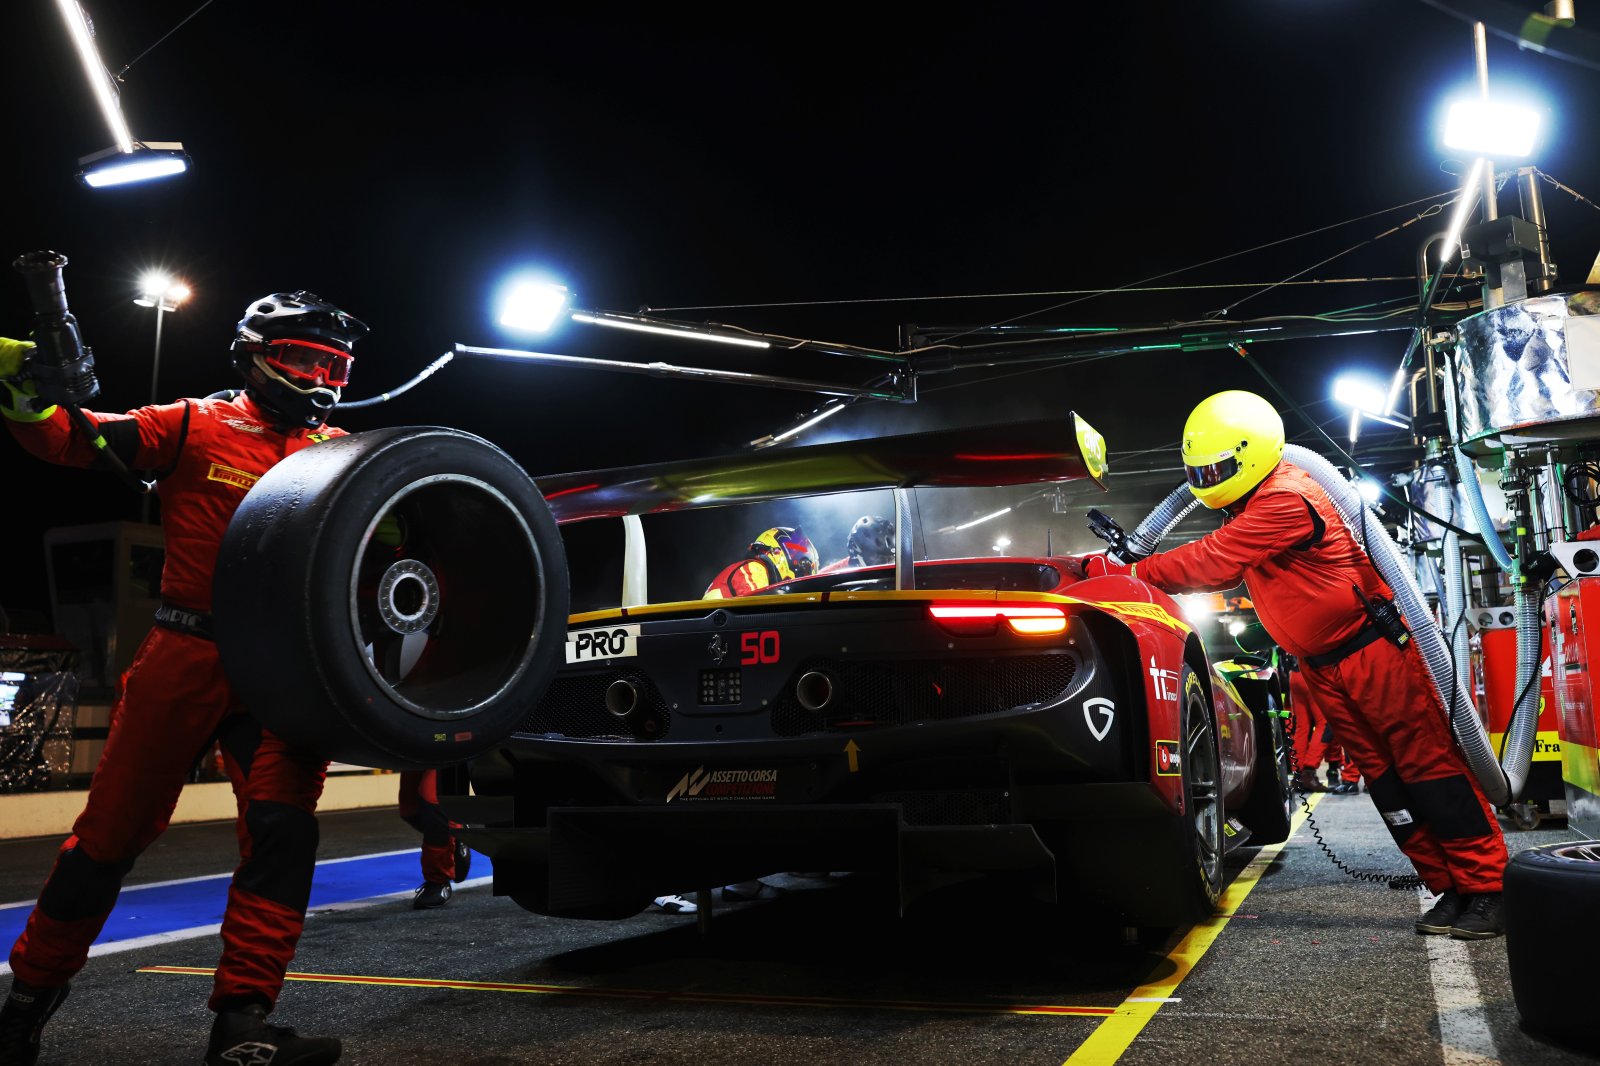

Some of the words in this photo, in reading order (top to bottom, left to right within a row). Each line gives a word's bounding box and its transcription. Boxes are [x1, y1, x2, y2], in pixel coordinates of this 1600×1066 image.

[1113, 603, 1169, 621] PIRELLI
[575, 628, 628, 659] PRO
[740, 630, 781, 665] 50
[710, 770, 748, 783] ASSETTO
[749, 769, 777, 782] CORSA
